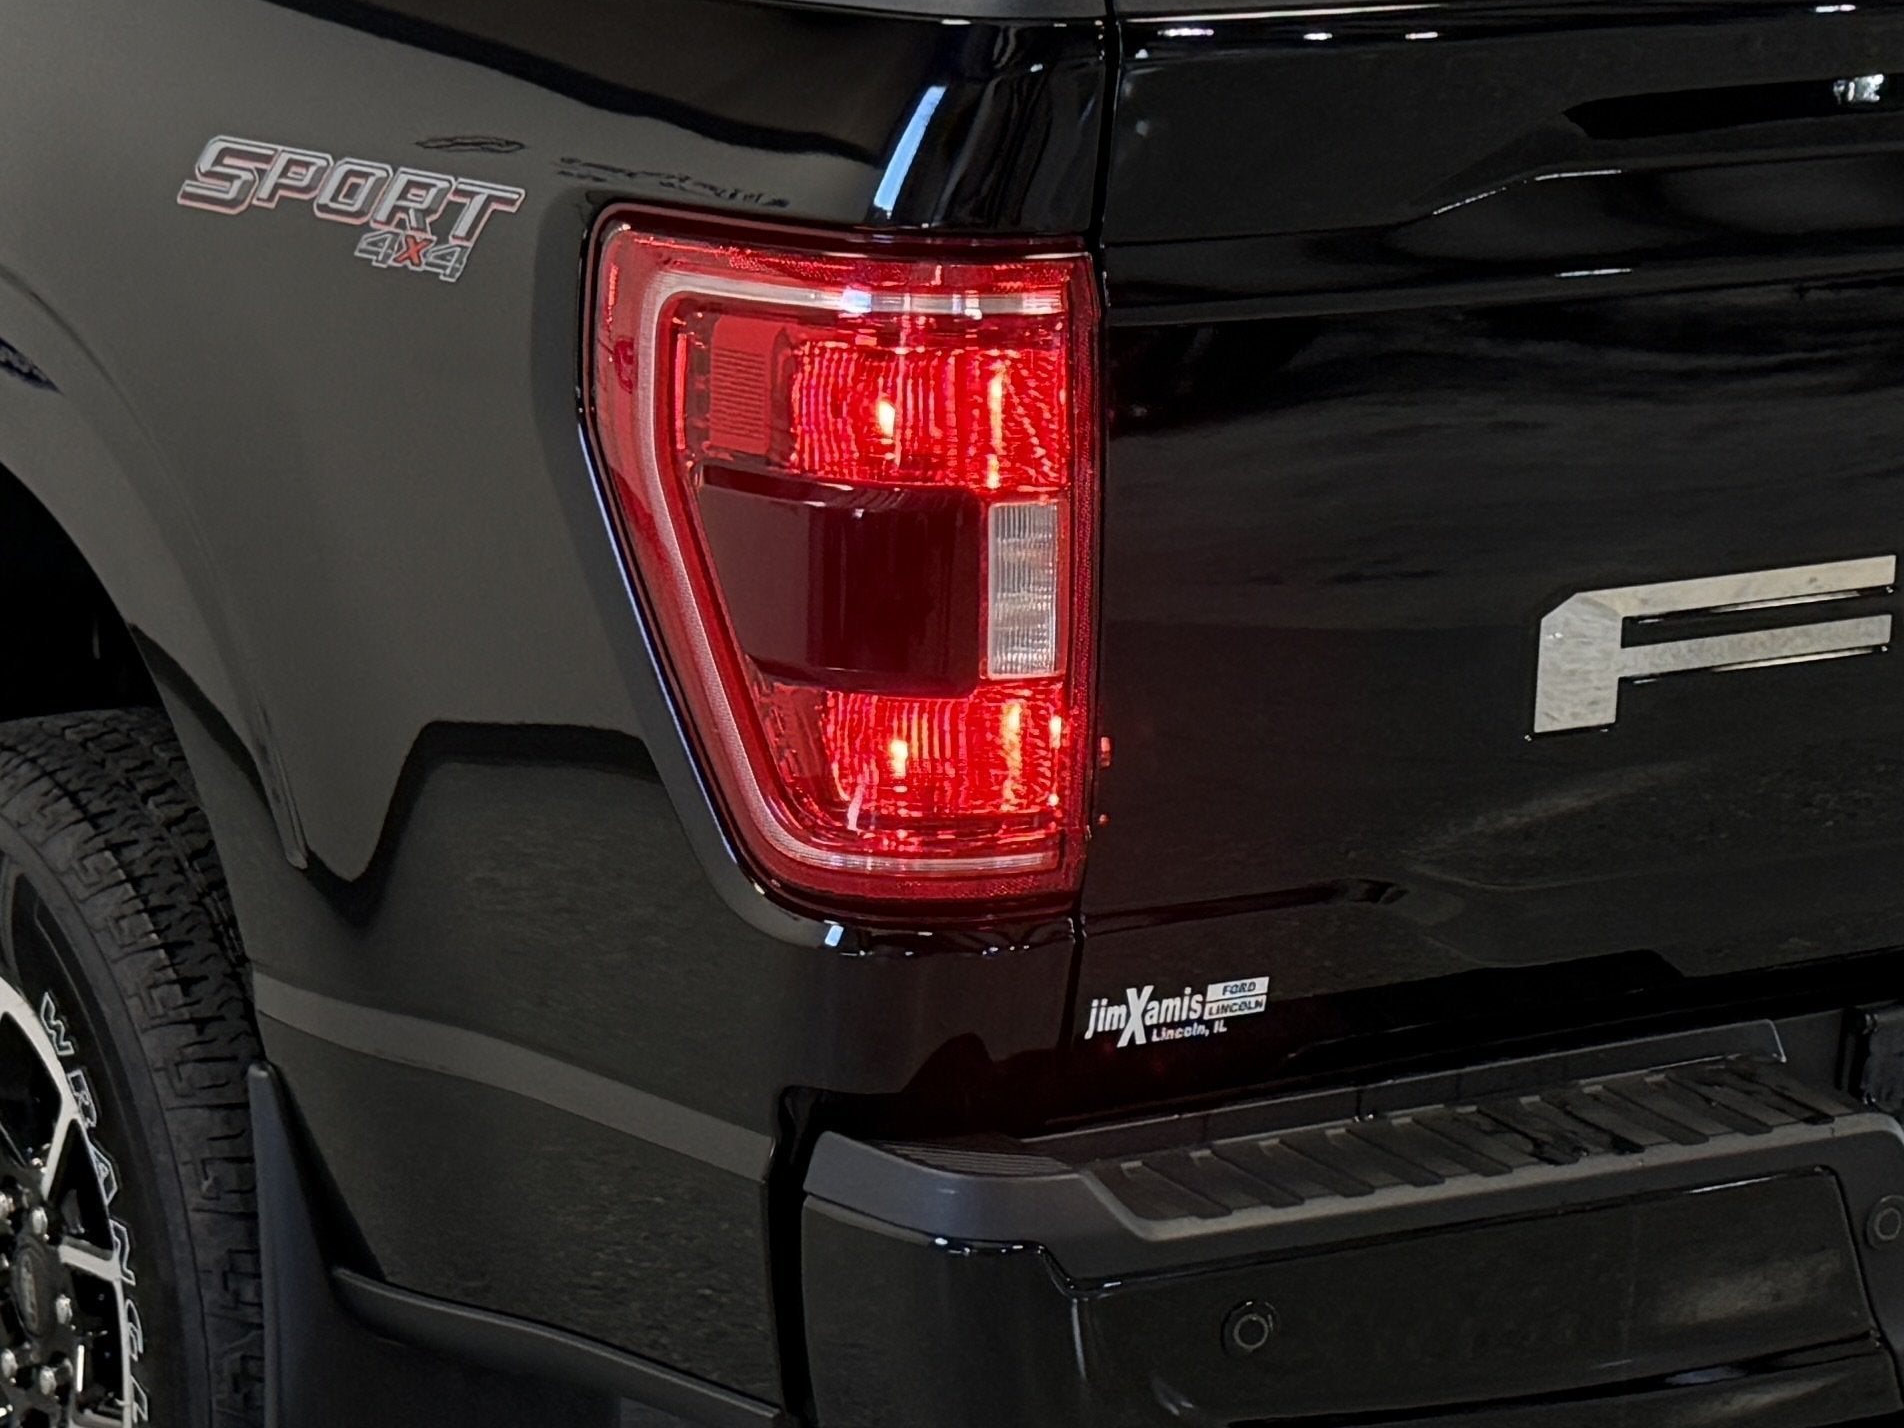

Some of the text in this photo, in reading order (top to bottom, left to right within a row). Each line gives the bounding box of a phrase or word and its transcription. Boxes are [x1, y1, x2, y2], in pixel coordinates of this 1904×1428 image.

[177, 135, 526, 247] SPORT
[1222, 981, 1256, 996] FORD
[1208, 999, 1264, 1016] LINCOLN
[1151, 1019, 1228, 1042] Lincoln, IL
